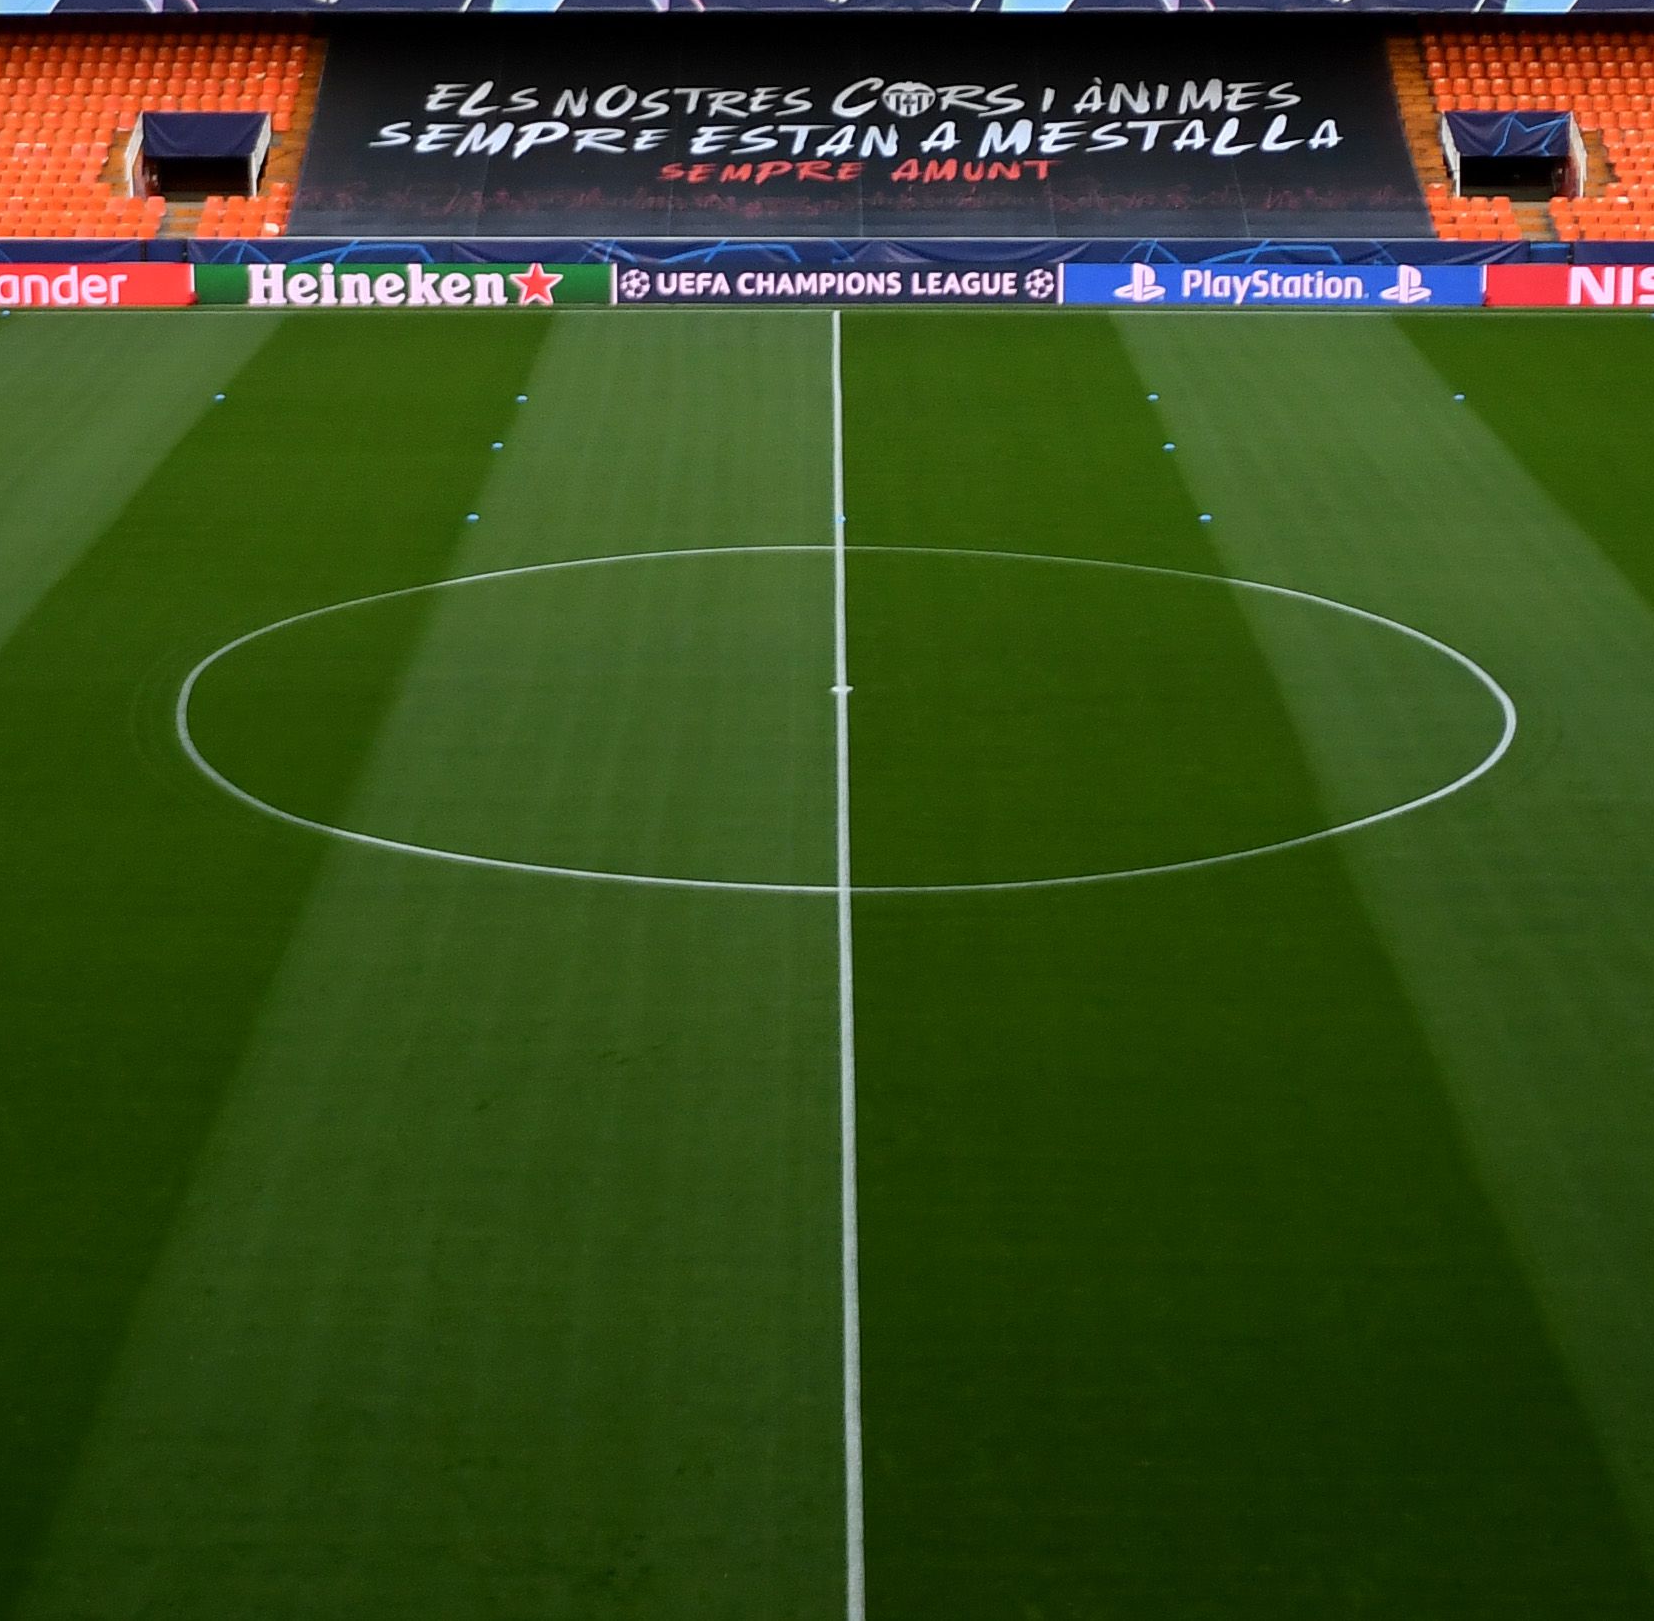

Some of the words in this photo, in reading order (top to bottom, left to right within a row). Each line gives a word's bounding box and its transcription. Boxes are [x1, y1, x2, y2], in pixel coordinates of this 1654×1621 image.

[425, 80, 539, 118] ELS
[552, 83, 814, 122] NOSTRES
[1041, 86, 1054, 113] I
[1073, 77, 1302, 116] ÀNIMES
[368, 120, 671, 160] SEMPRE
[690, 122, 899, 159] ESTAN
[919, 119, 962, 155] A
[977, 113, 1344, 159] MESTALLA
[657, 160, 865, 187] SEMPRE
[890, 158, 1063, 185] AMUNT
[247, 262, 510, 307] Heineken
[656, 269, 731, 296] UEFA
[736, 269, 903, 296] CHAMPIONS
[910, 269, 1017, 296] LEAGUE
[1181, 268, 1365, 305] PlayStation
